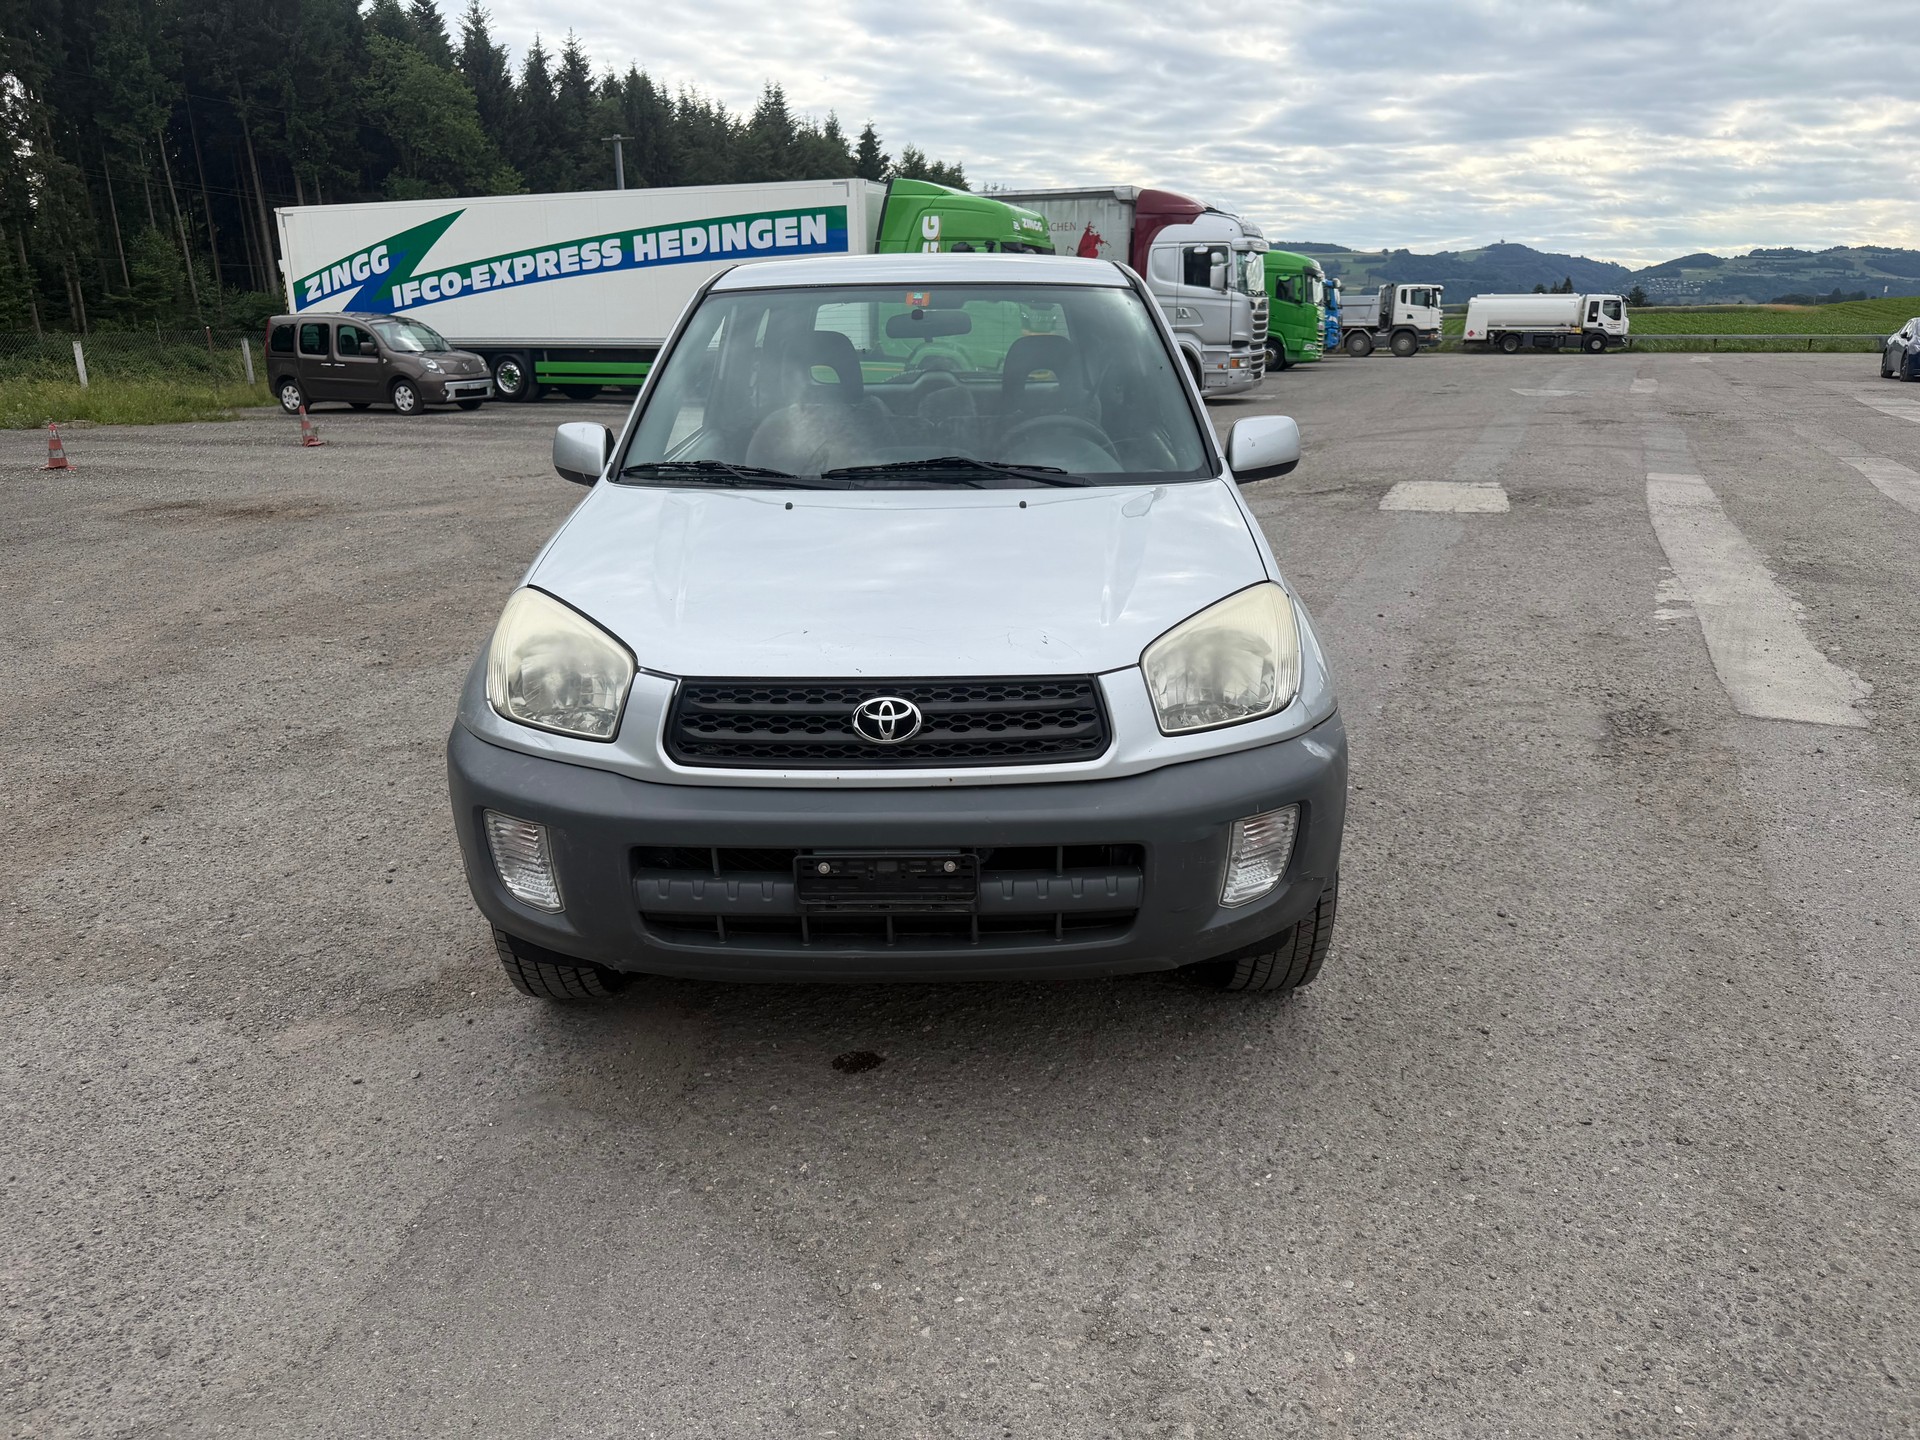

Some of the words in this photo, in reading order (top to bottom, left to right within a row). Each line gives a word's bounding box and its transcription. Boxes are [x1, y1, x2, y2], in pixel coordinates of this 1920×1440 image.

[304, 245, 390, 302] ZINGG
[391, 238, 622, 308] IFCO-EXPRESS
[633, 214, 827, 262] HEDINGEN
